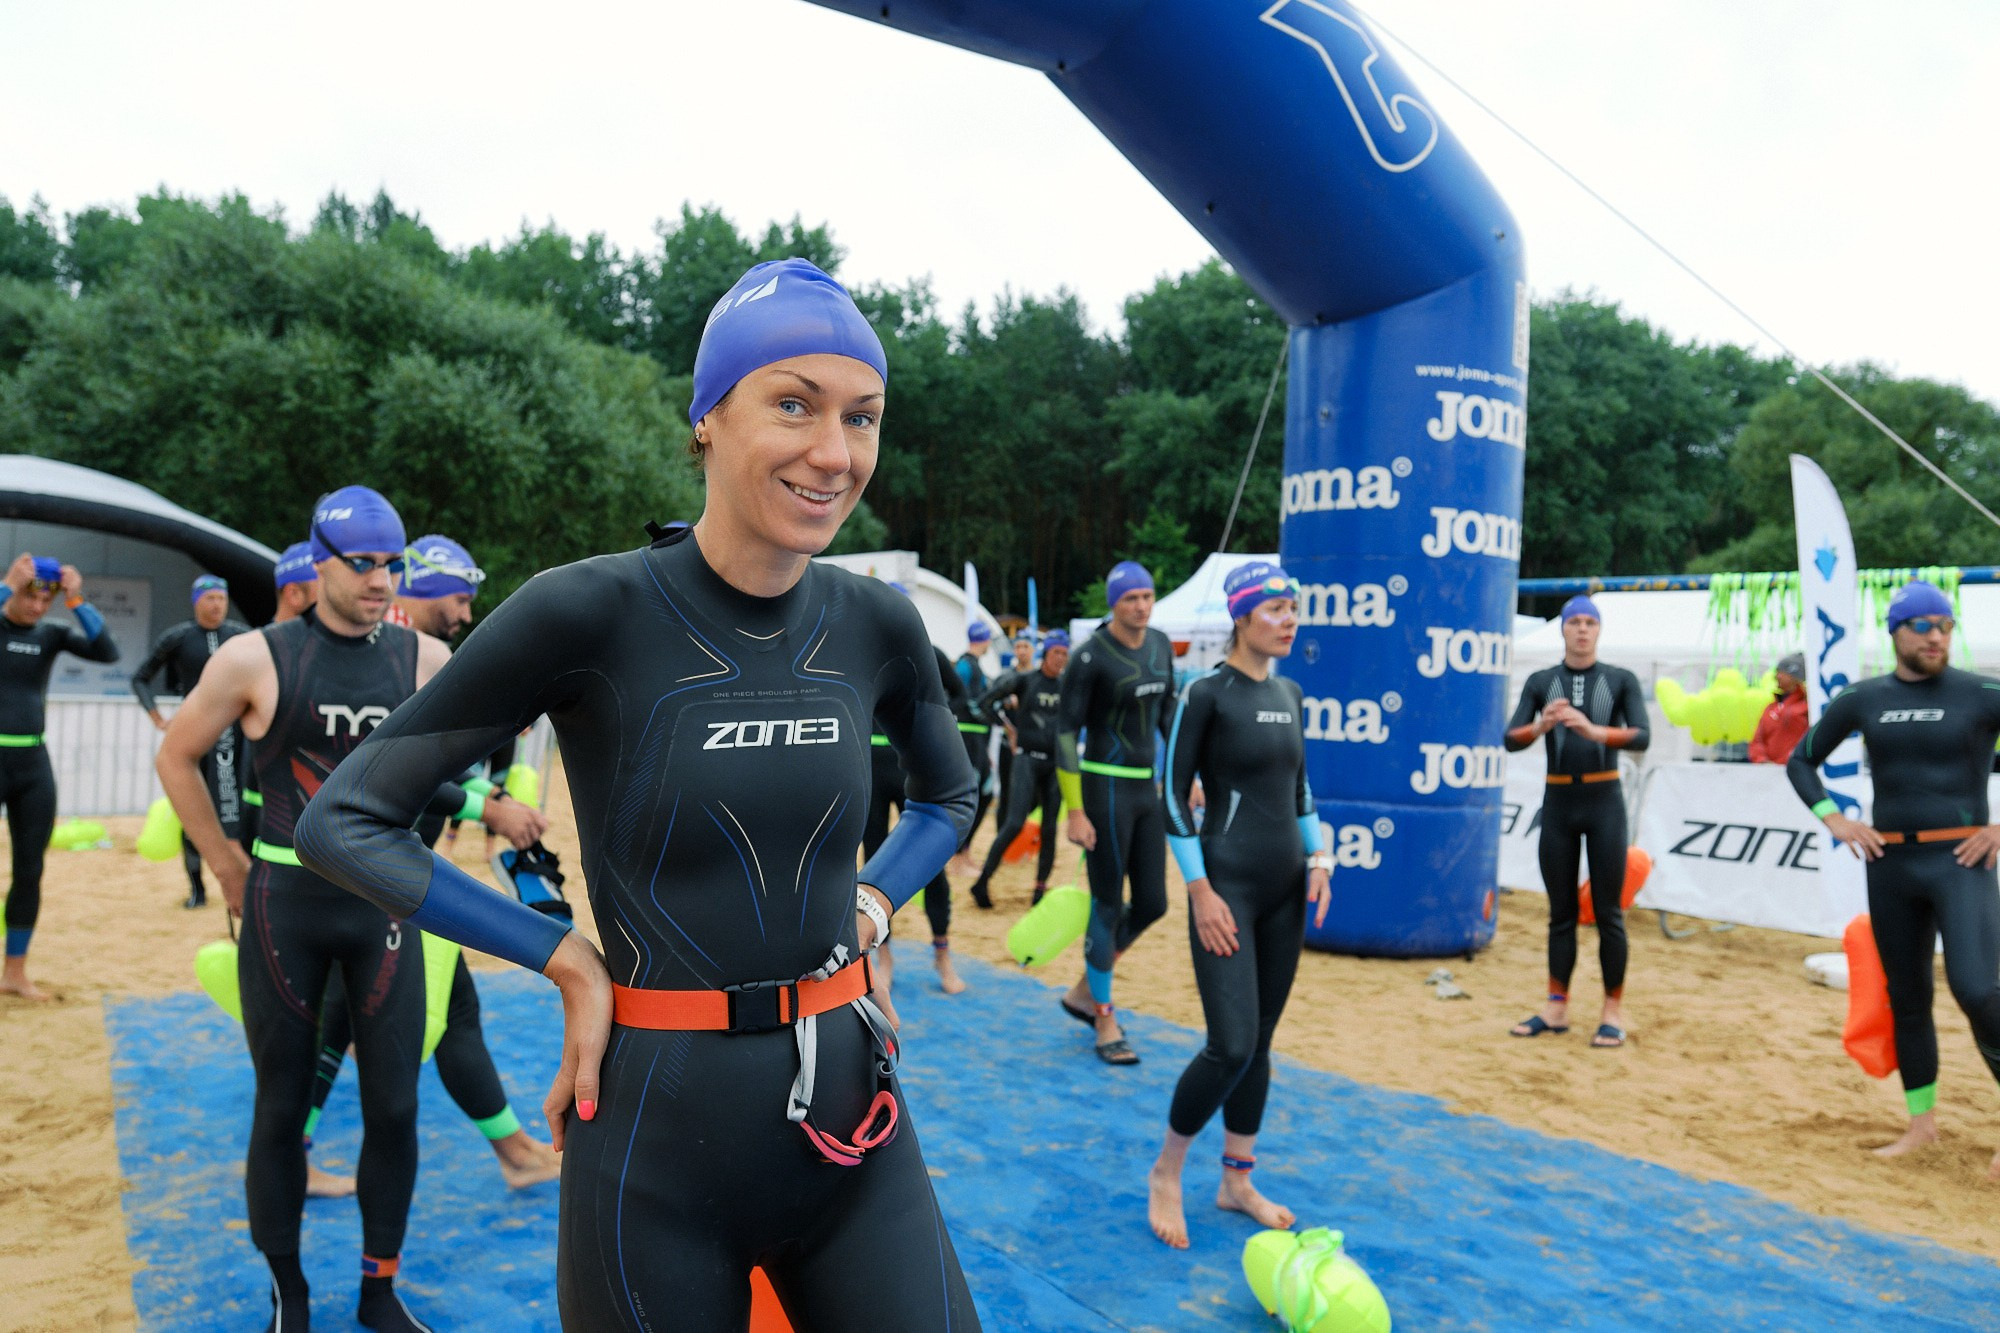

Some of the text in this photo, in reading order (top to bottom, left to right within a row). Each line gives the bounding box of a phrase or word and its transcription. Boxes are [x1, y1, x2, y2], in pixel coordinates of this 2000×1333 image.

[1427, 390, 1526, 450] Jom
[1421, 506, 1521, 562] Jom
[1297, 583, 1396, 628] ma
[1417, 626, 1511, 678] Jom
[703, 717, 839, 750] ZONE3
[1302, 696, 1390, 744] ma
[1410, 742, 1506, 795] Jom
[1669, 820, 1820, 871] ZONE
